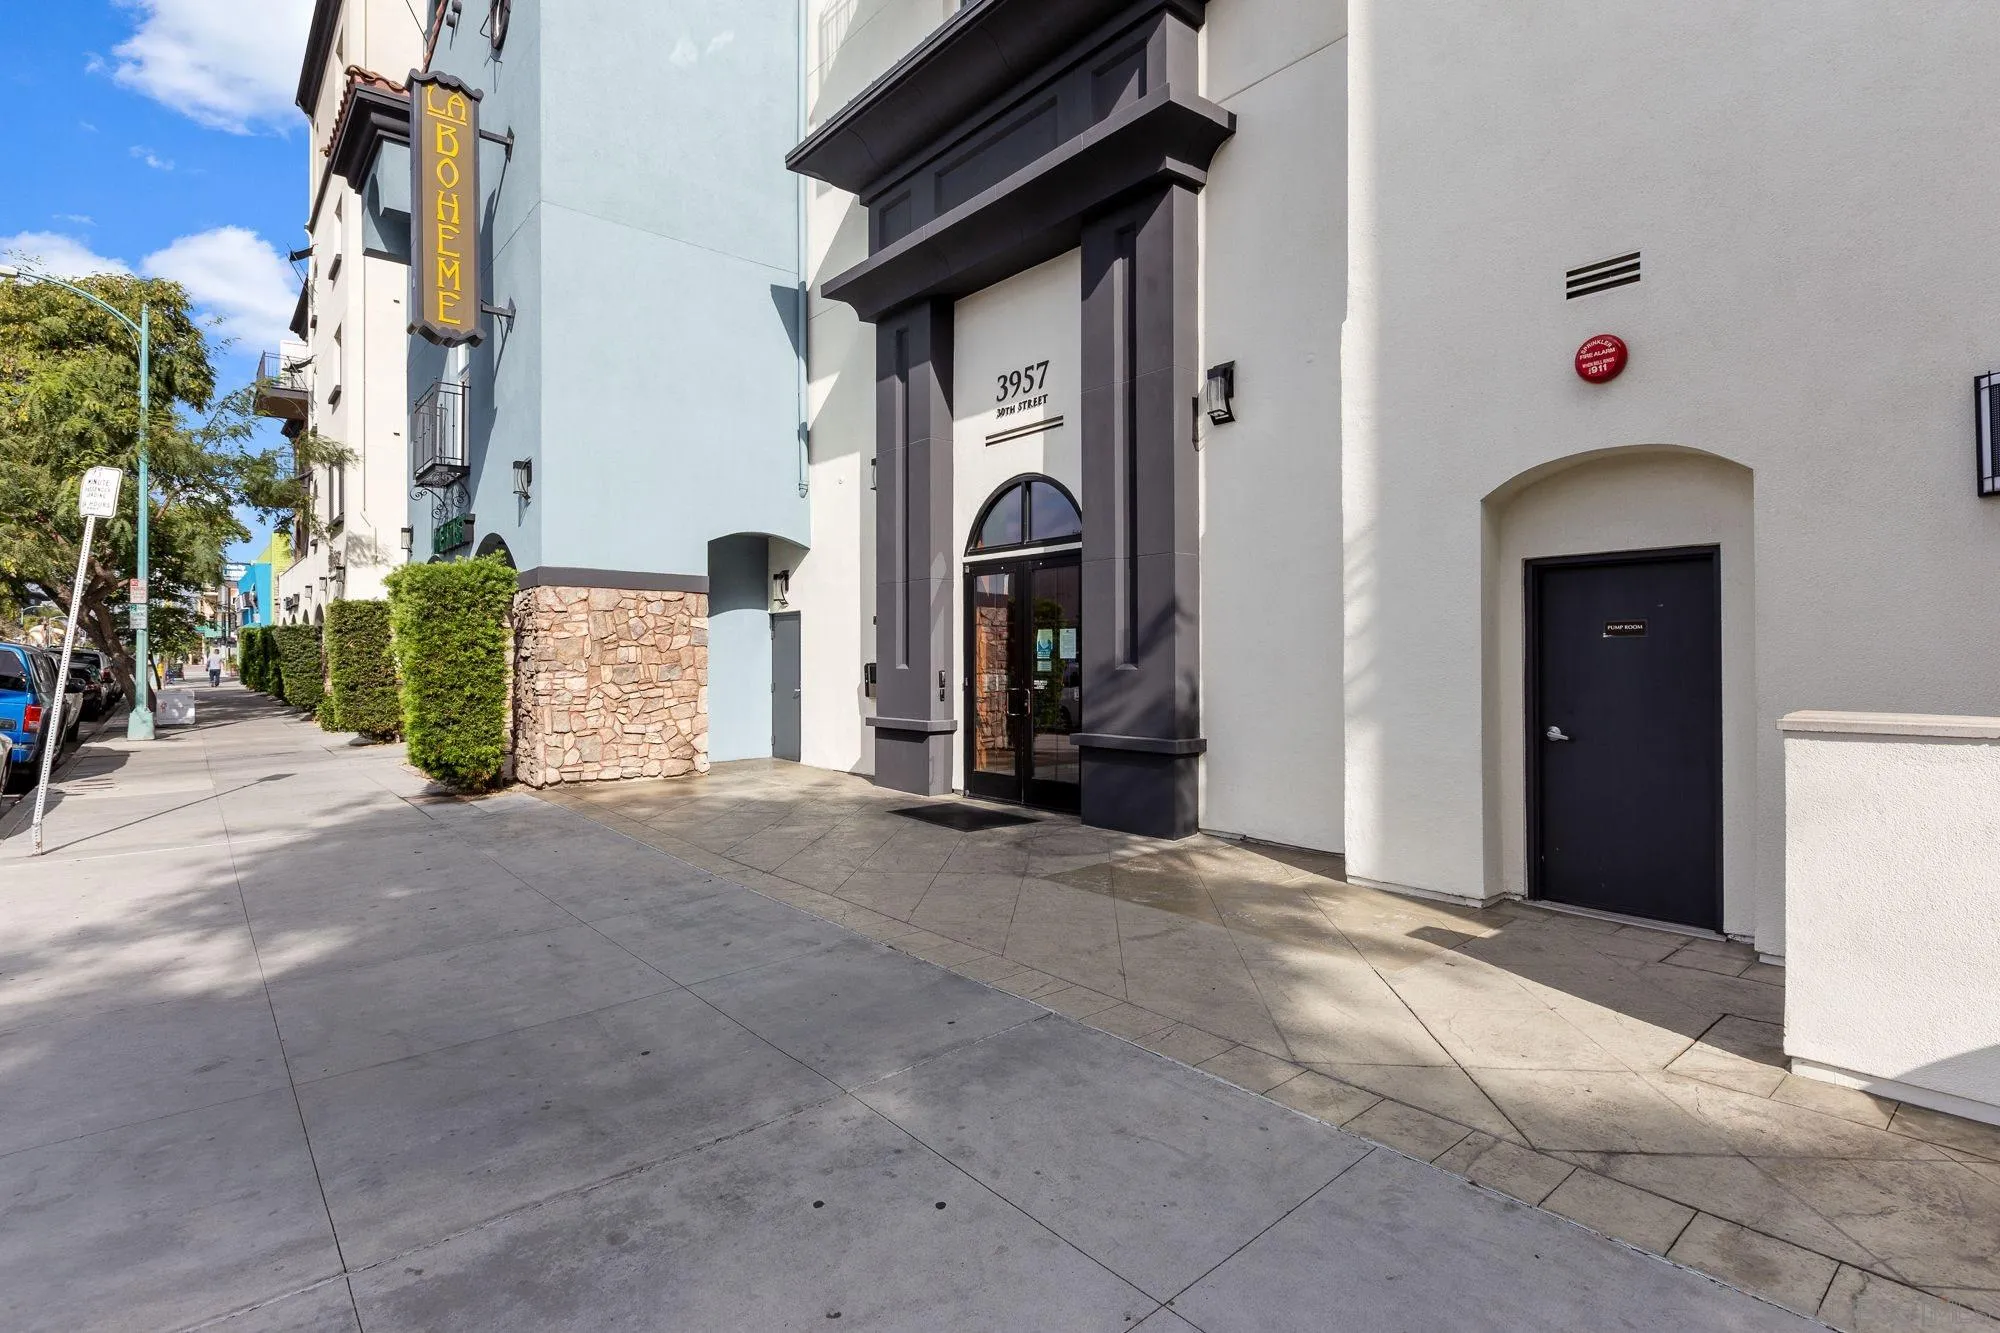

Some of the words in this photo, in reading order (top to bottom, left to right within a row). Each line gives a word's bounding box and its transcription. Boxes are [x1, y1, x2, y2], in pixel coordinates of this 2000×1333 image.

[426, 84, 467, 122] LA
[436, 122, 461, 325] BOHEME
[1579, 352, 1593, 360] FIRE
[1594, 347, 1615, 356] ALARM
[1580, 339, 1612, 354] SPRINKLER
[1591, 363, 1607, 373] 911
[996, 360, 1049, 402] 3957
[996, 405, 1016, 419] 30TH
[1018, 394, 1048, 412] STREET
